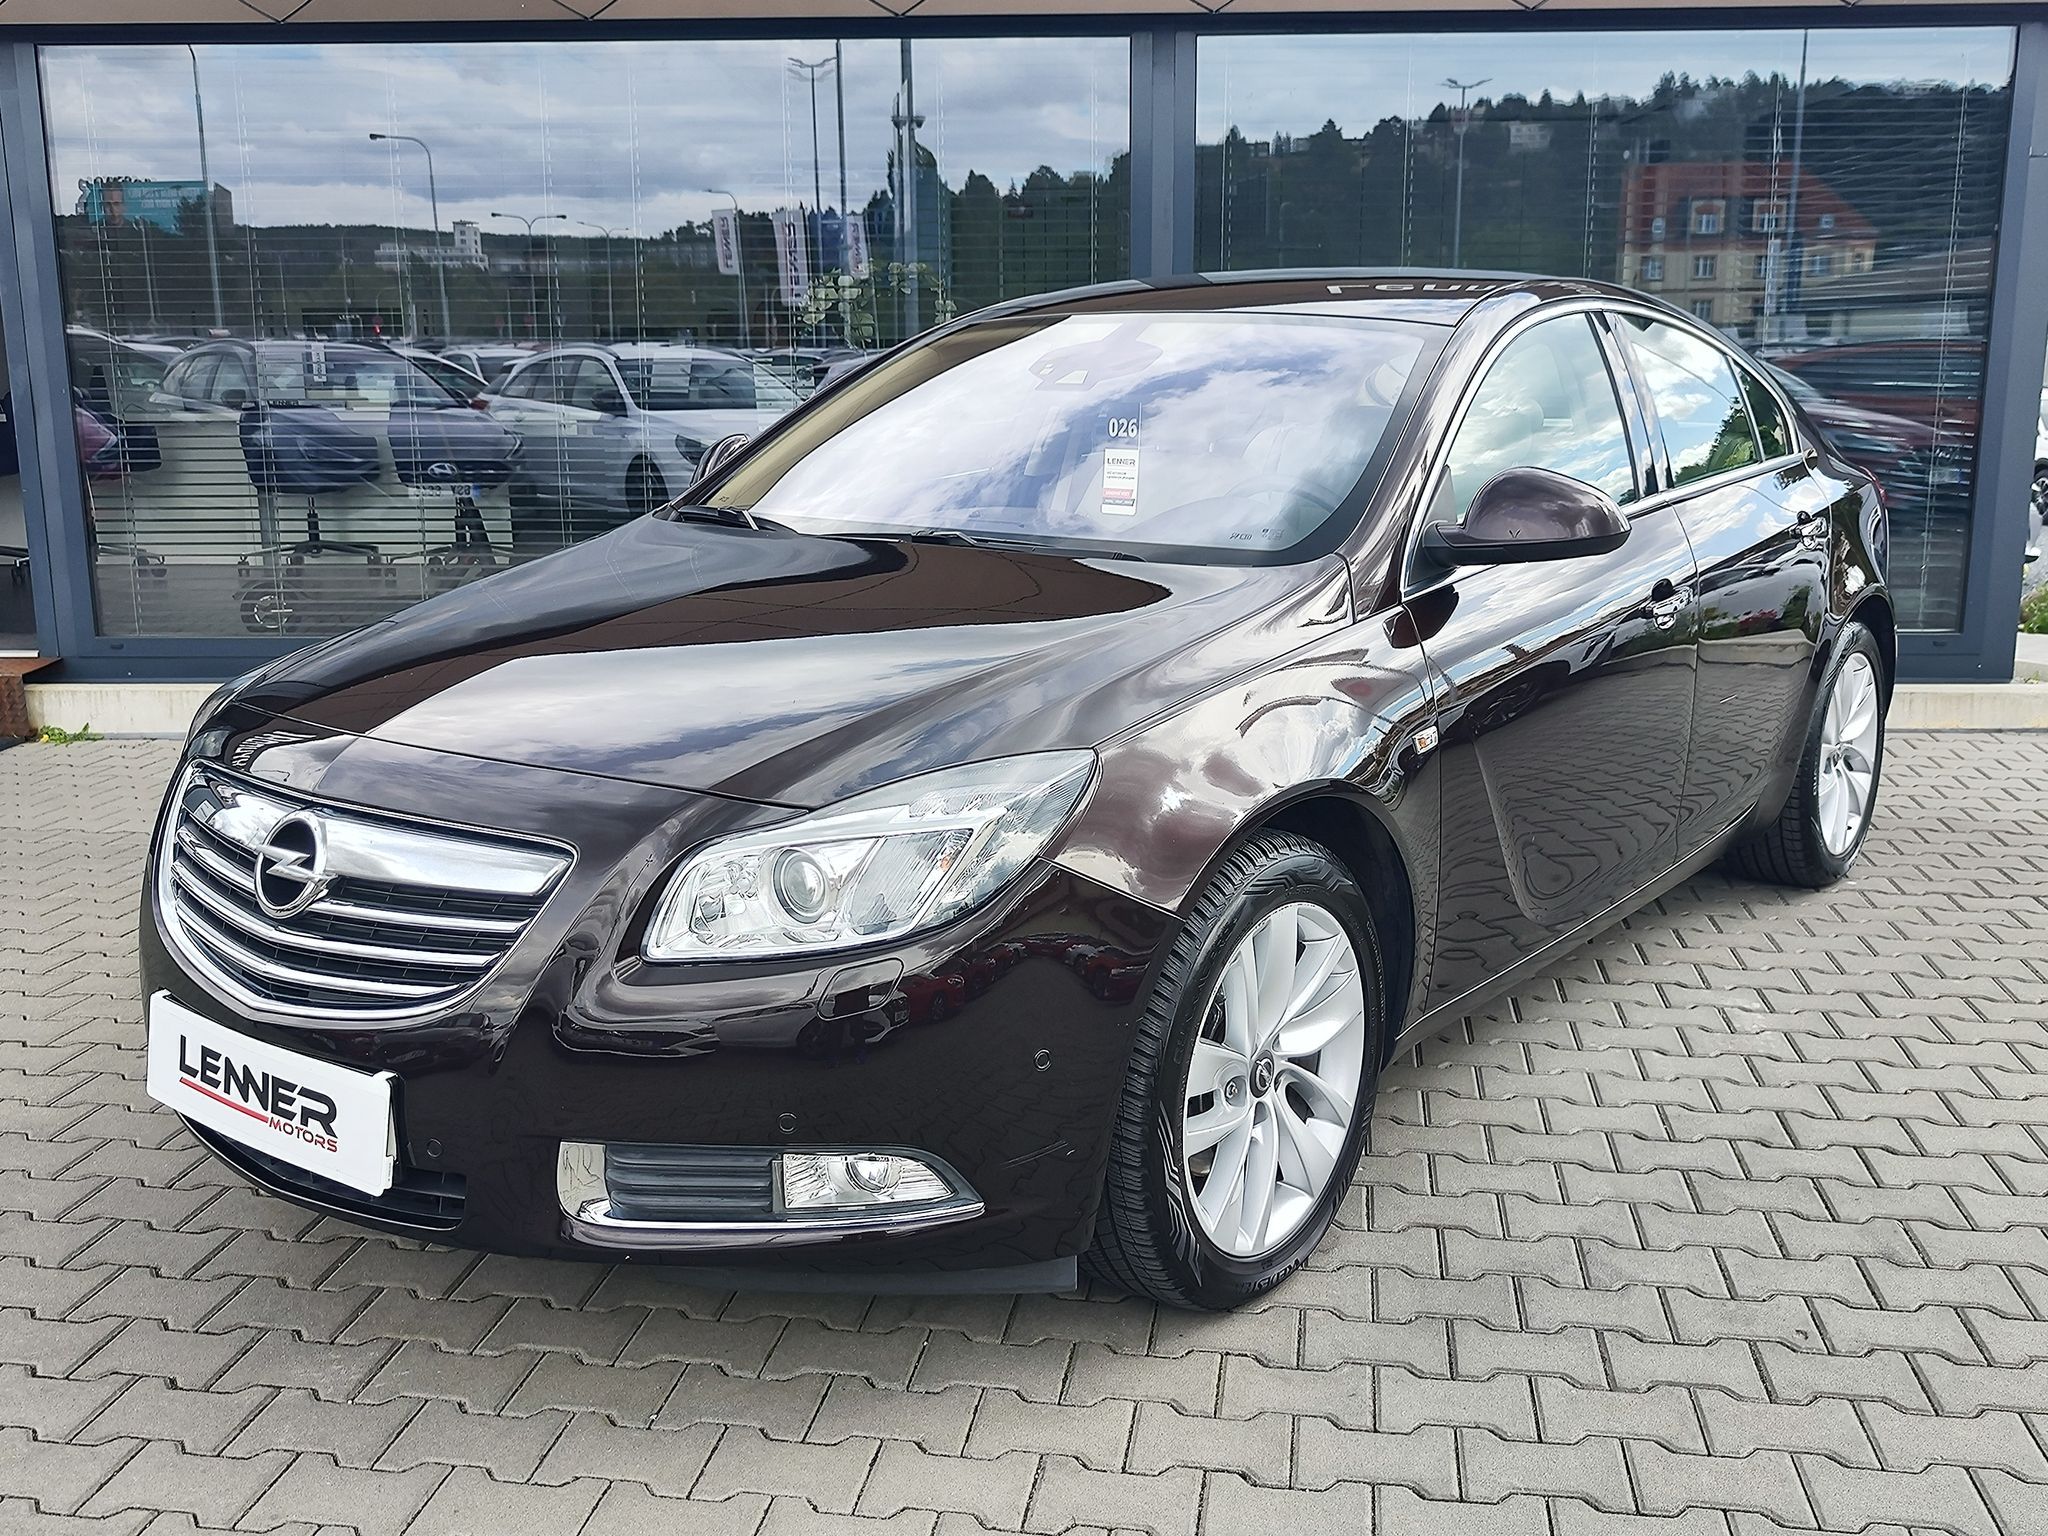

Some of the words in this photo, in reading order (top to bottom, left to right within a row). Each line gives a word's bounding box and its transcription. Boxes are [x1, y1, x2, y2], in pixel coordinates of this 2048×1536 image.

[1108, 417, 1138, 438] 026
[179, 1034, 338, 1139] LENNER
[268, 1116, 338, 1153] MOTORS
